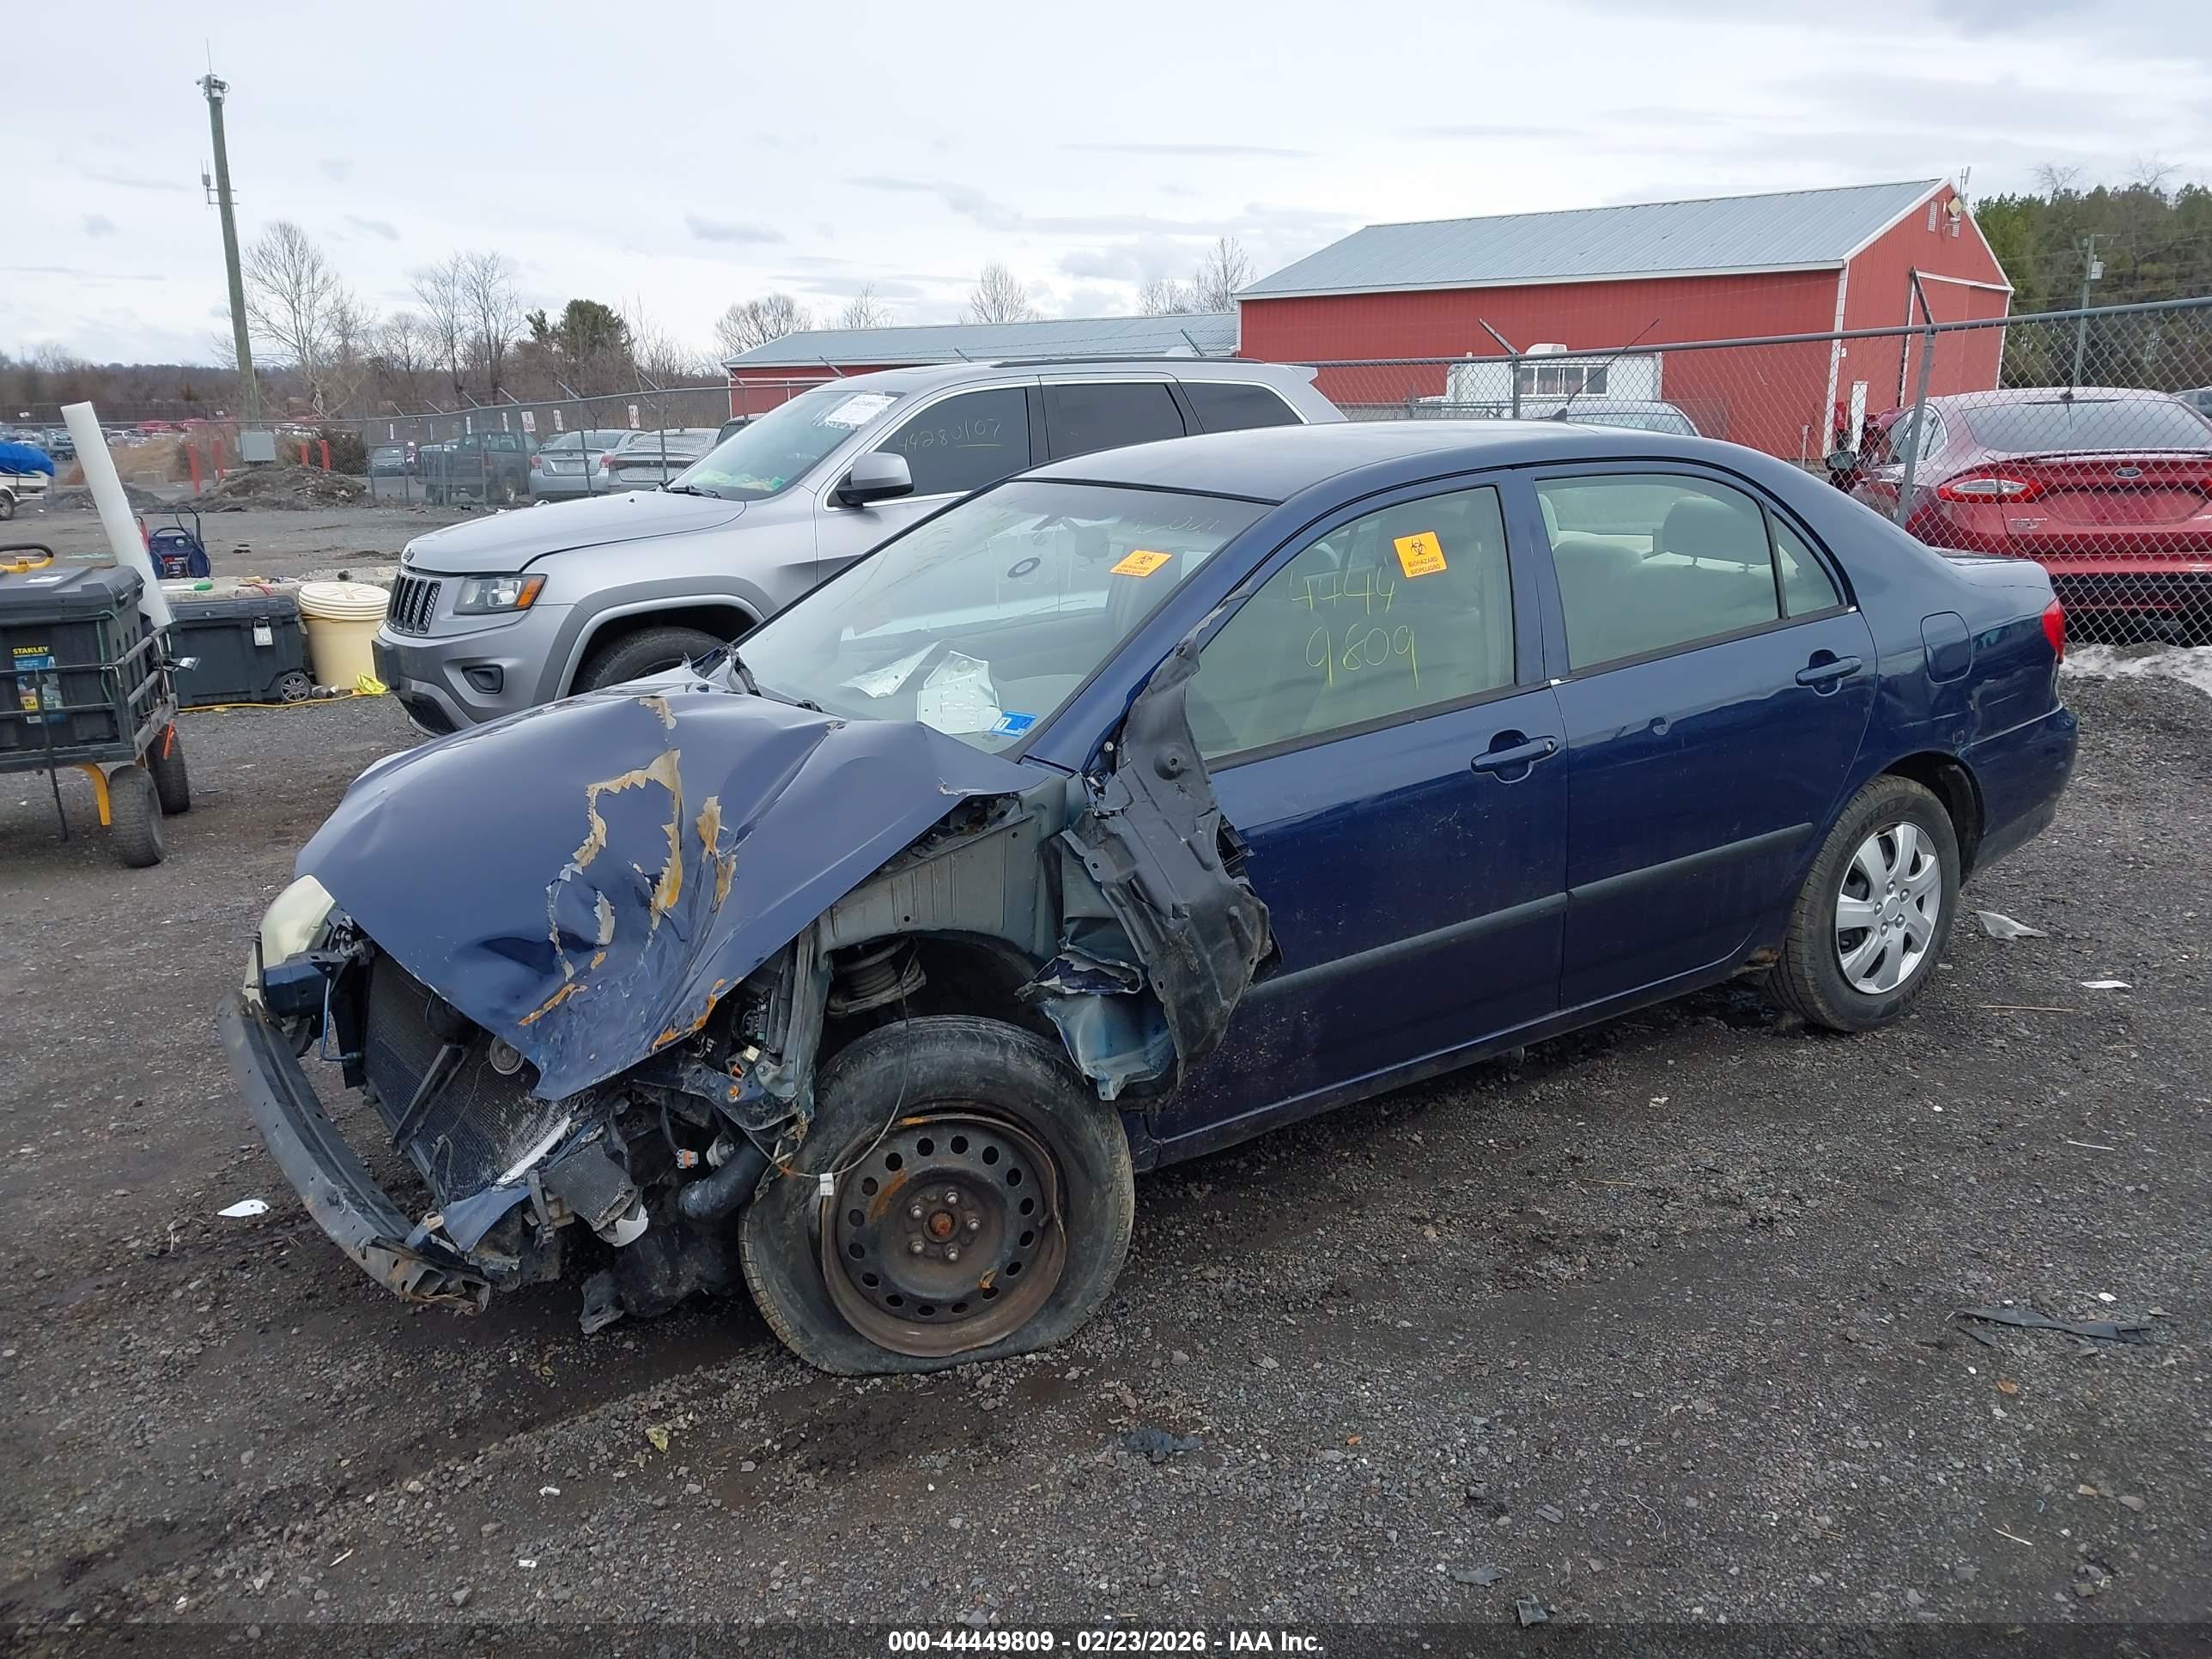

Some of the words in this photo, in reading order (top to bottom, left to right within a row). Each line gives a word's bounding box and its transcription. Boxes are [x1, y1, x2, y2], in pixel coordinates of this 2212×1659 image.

[1408, 556, 1438, 568] BIOHAZARD
[1290, 556, 1395, 616] 4444
[12, 646, 49, 654] STANLEY
[1306, 623, 1419, 690] 9809
